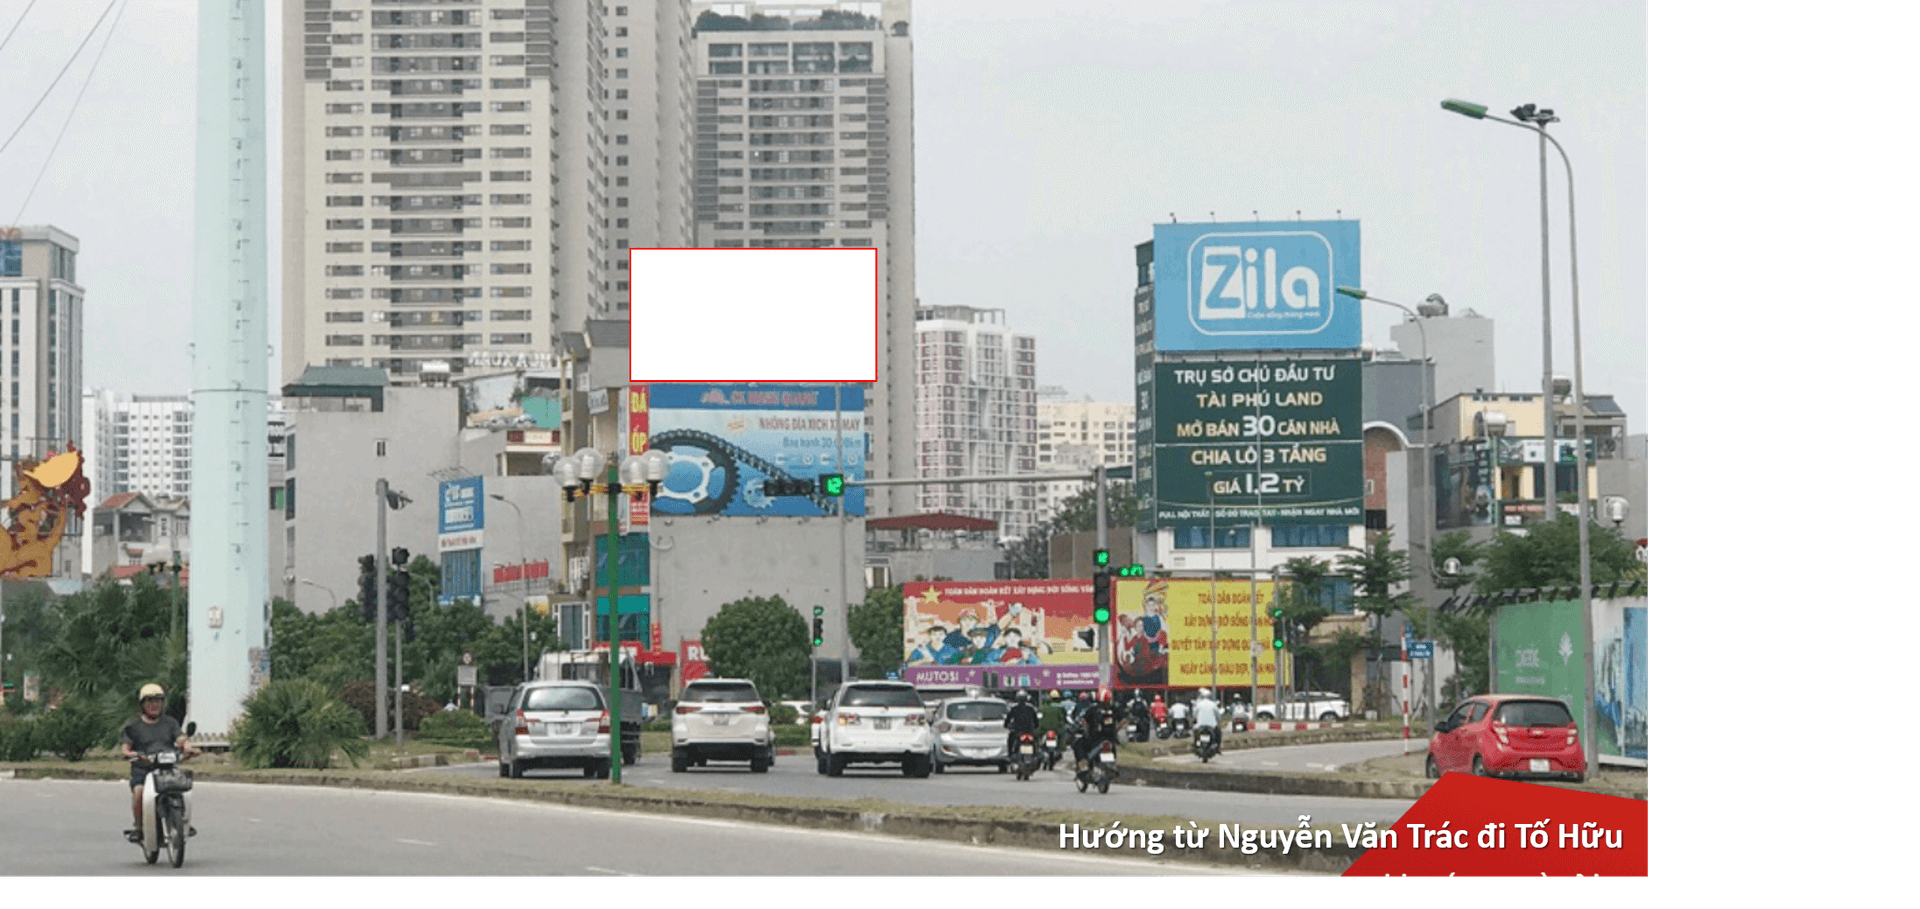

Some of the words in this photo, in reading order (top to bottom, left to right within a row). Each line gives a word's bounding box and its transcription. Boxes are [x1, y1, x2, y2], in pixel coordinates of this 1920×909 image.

[1200, 246, 1320, 319] Zila
[1174, 370, 1207, 387] TRỤ
[1211, 366, 1234, 383] SỞ
[1238, 366, 1270, 382] CHỦ
[1312, 365, 1336, 381] TƯ
[1196, 391, 1226, 408] TÀI
[1232, 390, 1270, 407] PHÚ
[1275, 392, 1323, 407] LAND
[1176, 420, 1203, 437] MỞ
[1206, 420, 1239, 437] BÁN
[1242, 415, 1275, 436] 30
[1277, 420, 1307, 436] CĂN
[1310, 418, 1341, 435] NHÀ
[1191, 450, 1232, 465] CHIA
[1235, 446, 1258, 464] LÔ
[1263, 450, 1275, 463] 3
[1213, 477, 1242, 494] GIÁ
